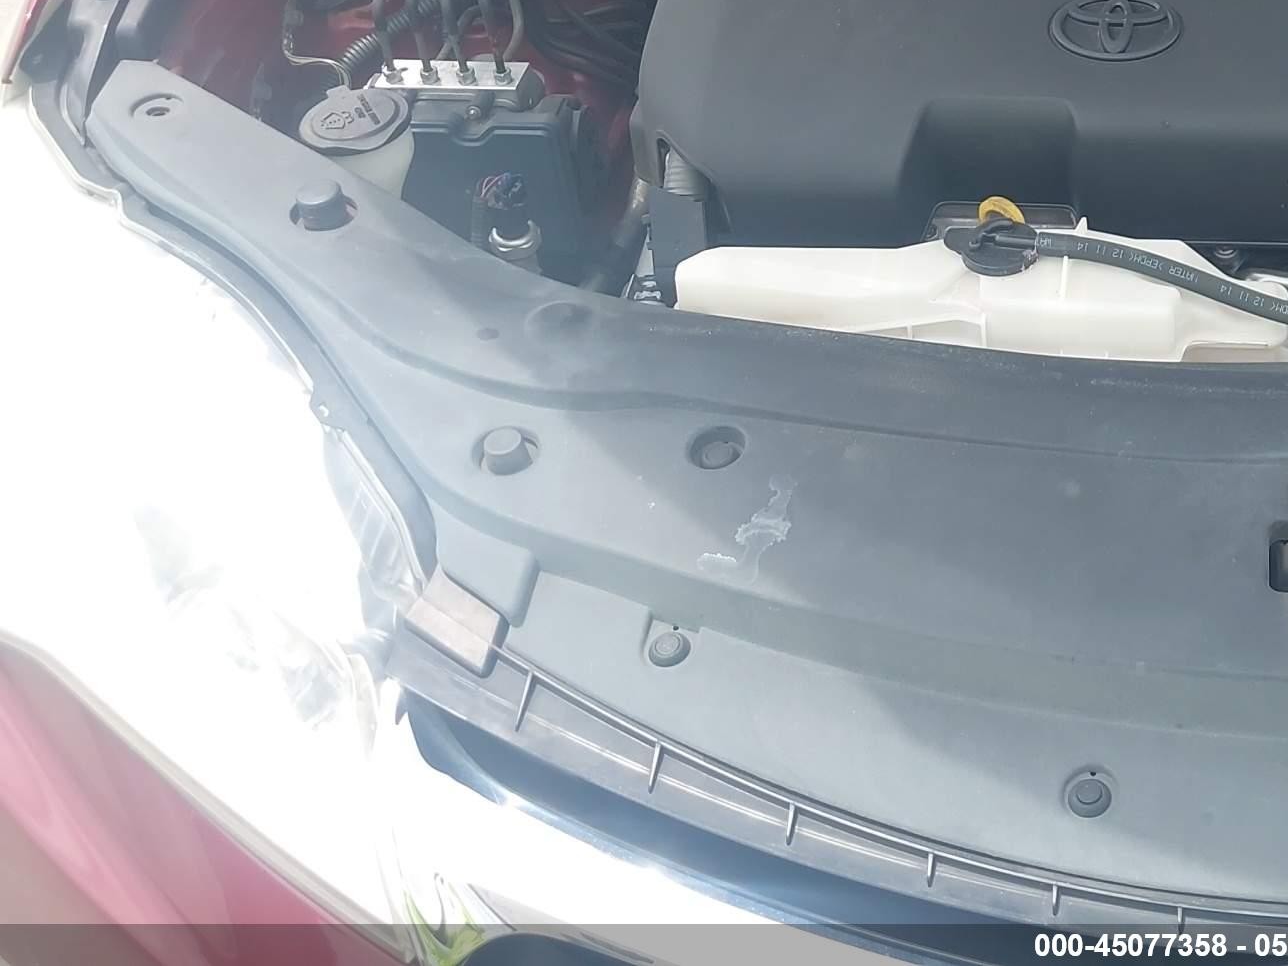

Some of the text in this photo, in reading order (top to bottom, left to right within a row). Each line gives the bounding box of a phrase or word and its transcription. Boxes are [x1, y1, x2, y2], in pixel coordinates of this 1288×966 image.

[1077, 242, 1089, 251] 14
[1096, 246, 1106, 255] 11
[1112, 248, 1124, 258] 12
[1220, 285, 1232, 296] 14
[1239, 292, 1249, 301] 11
[1253, 296, 1265, 306] 12
